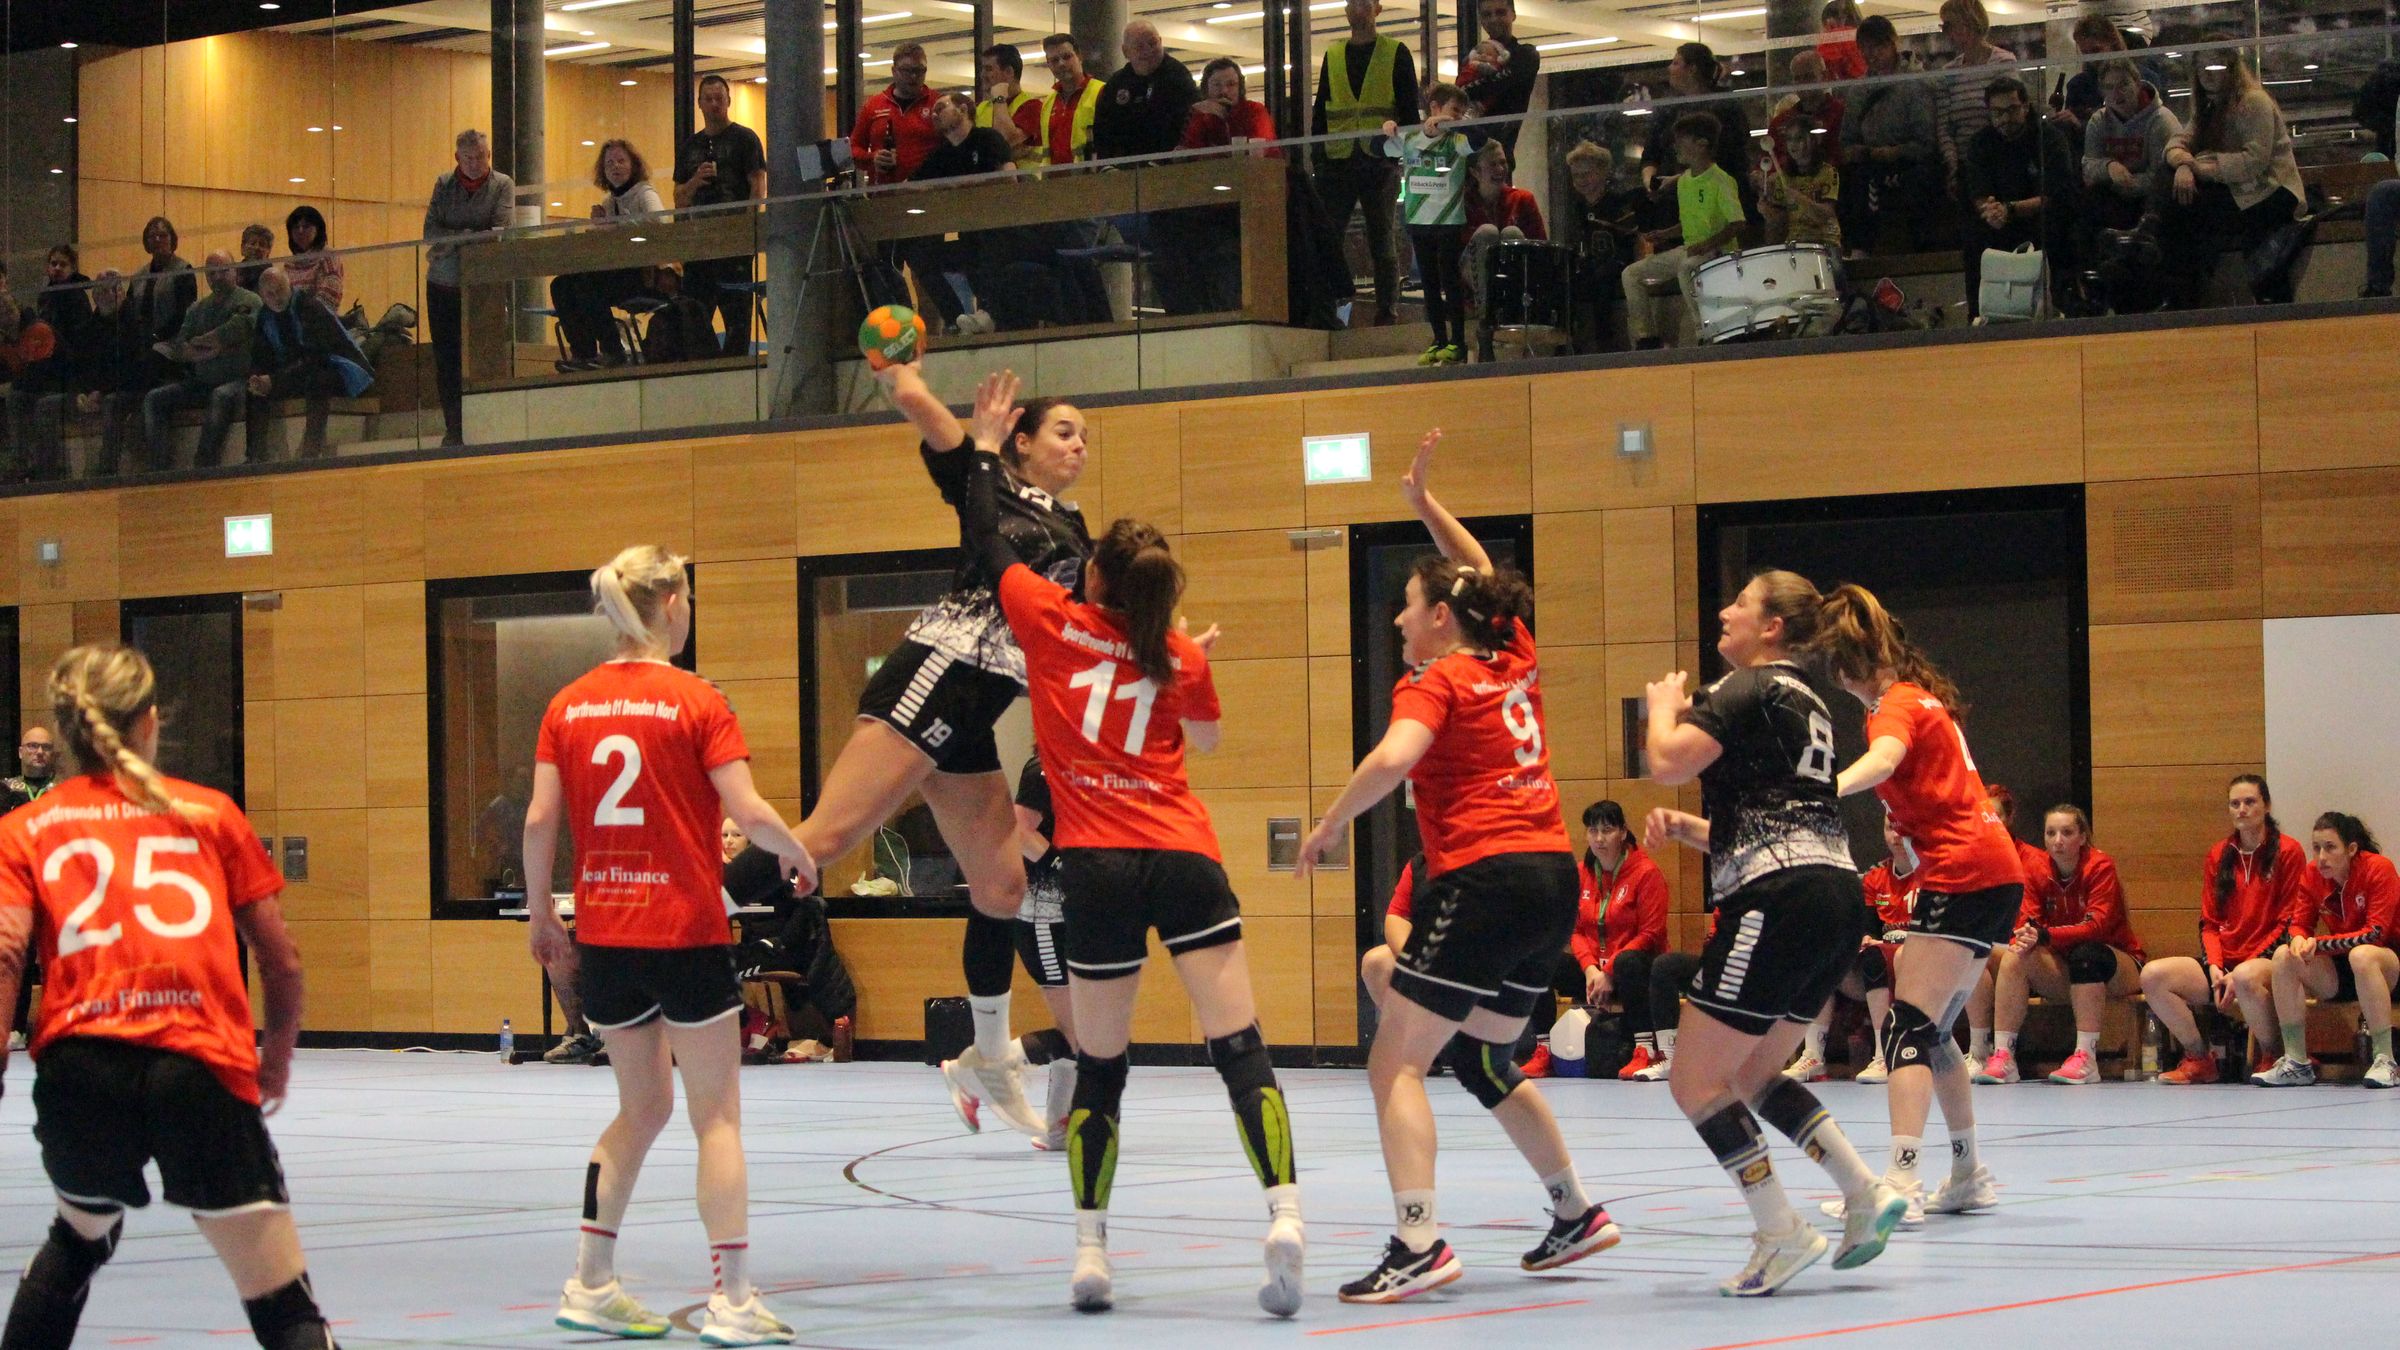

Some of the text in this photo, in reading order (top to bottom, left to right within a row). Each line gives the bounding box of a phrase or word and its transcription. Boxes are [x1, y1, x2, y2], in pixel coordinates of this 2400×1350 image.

[656, 700, 679, 721] Nord
[921, 717, 953, 748] 19
[1068, 660, 1157, 756] 11
[1501, 689, 1543, 768] 9
[591, 734, 645, 827] 2
[1797, 710, 1836, 783] 8
[42, 837, 213, 958] 25
[610, 866, 670, 885] Finance
[118, 988, 202, 1011] Finance
